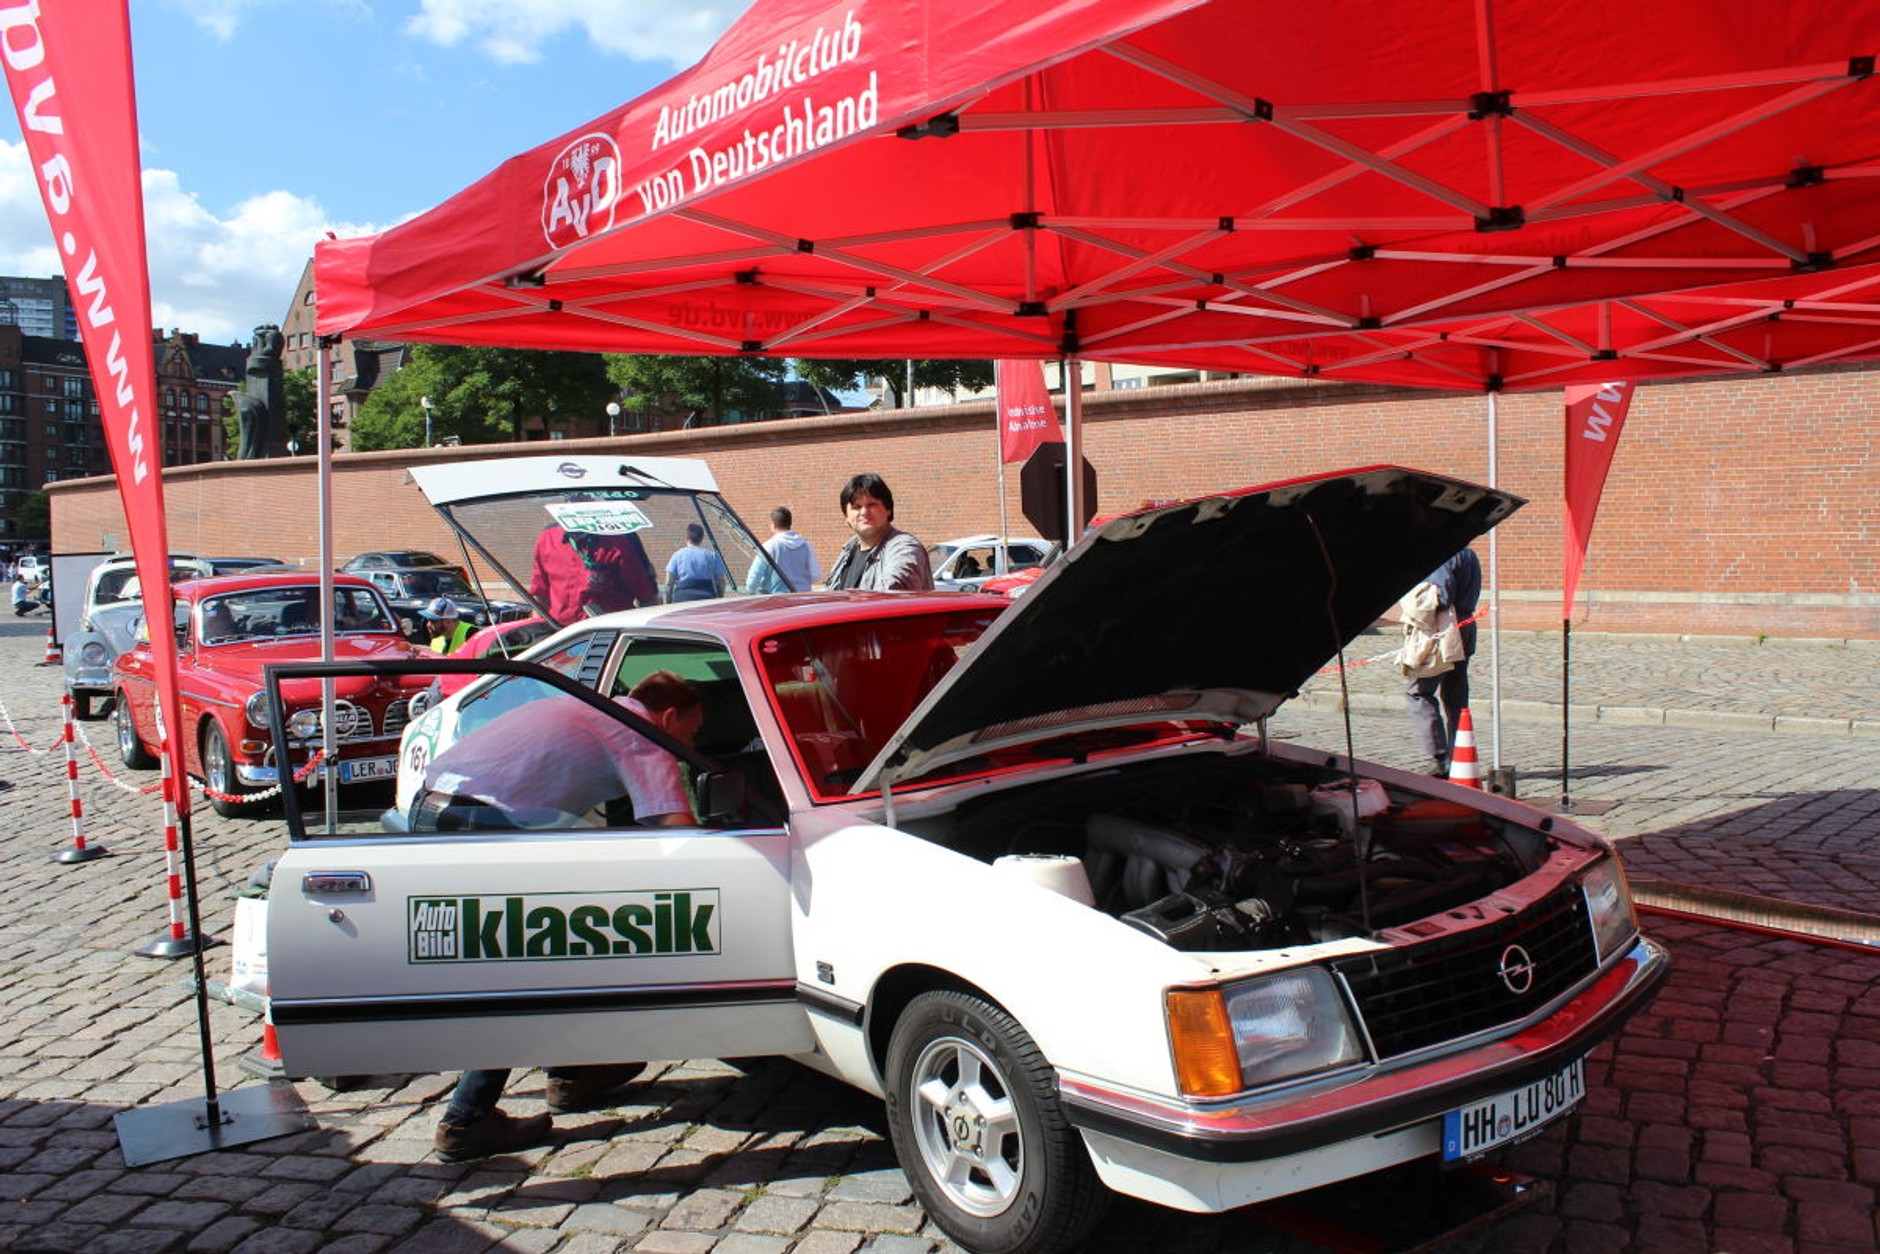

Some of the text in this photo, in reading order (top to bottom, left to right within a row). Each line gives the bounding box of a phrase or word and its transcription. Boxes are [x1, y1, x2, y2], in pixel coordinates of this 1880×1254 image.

[651, 11, 862, 150] Automobilclub
[638, 71, 878, 213] von Deutschland
[351, 761, 377, 777] LER
[411, 746, 428, 775] 161
[414, 892, 715, 959] Auto klassik
[415, 931, 456, 958] Bild
[1463, 1103, 1496, 1150] HH
[1513, 1083, 1540, 1129] LU
